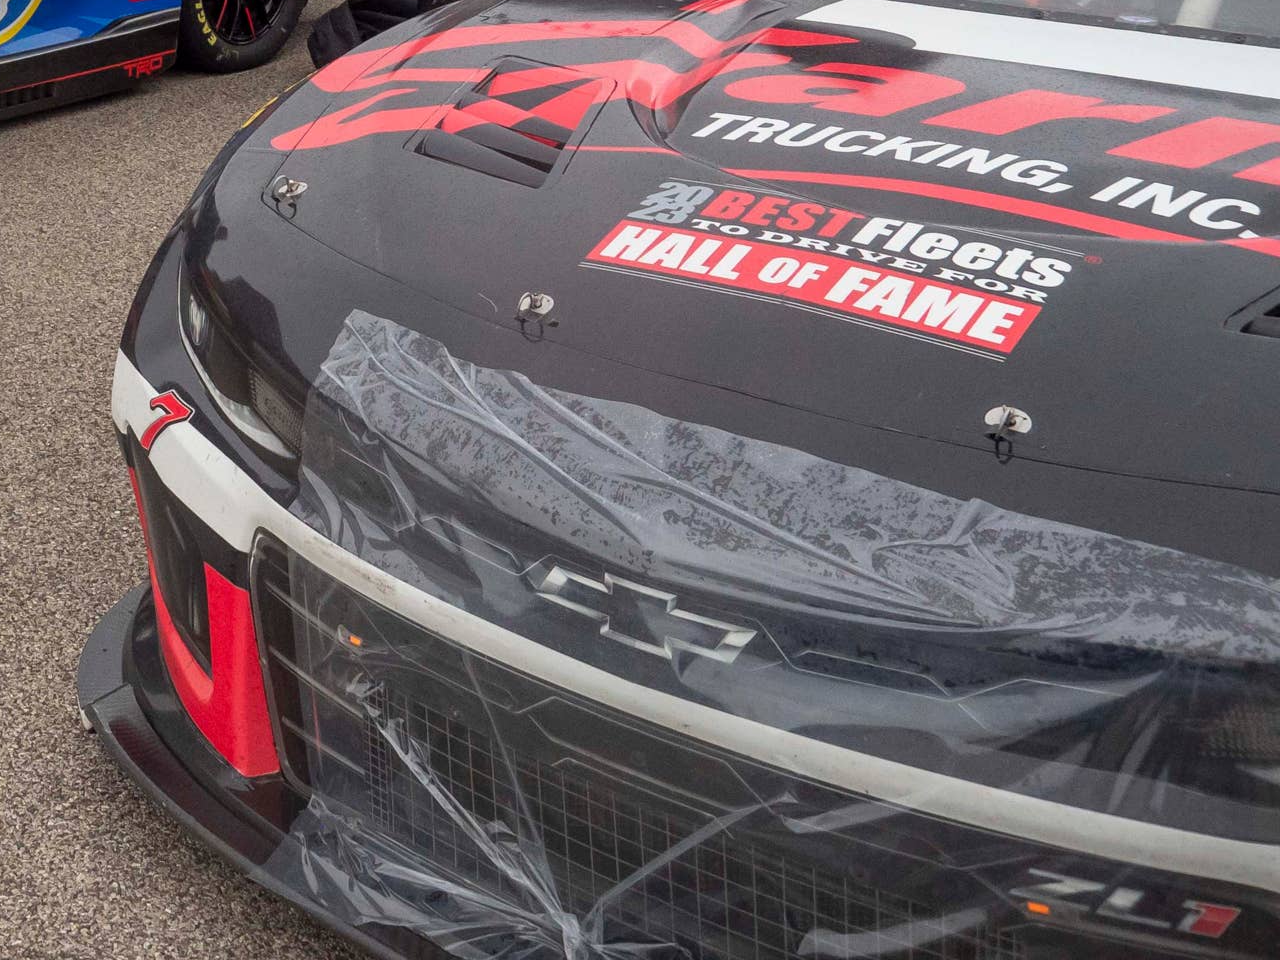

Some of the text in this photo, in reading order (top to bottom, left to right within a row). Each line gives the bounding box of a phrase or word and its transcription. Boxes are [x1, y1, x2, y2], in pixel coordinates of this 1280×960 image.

[691, 112, 1074, 194] TRUCKING,
[691, 217, 1049, 304] TO DRIVE FOR
[701, 189, 1073, 289] BEST Fleets
[599, 225, 1026, 345] HALL OF FAME
[140, 388, 195, 458] 7
